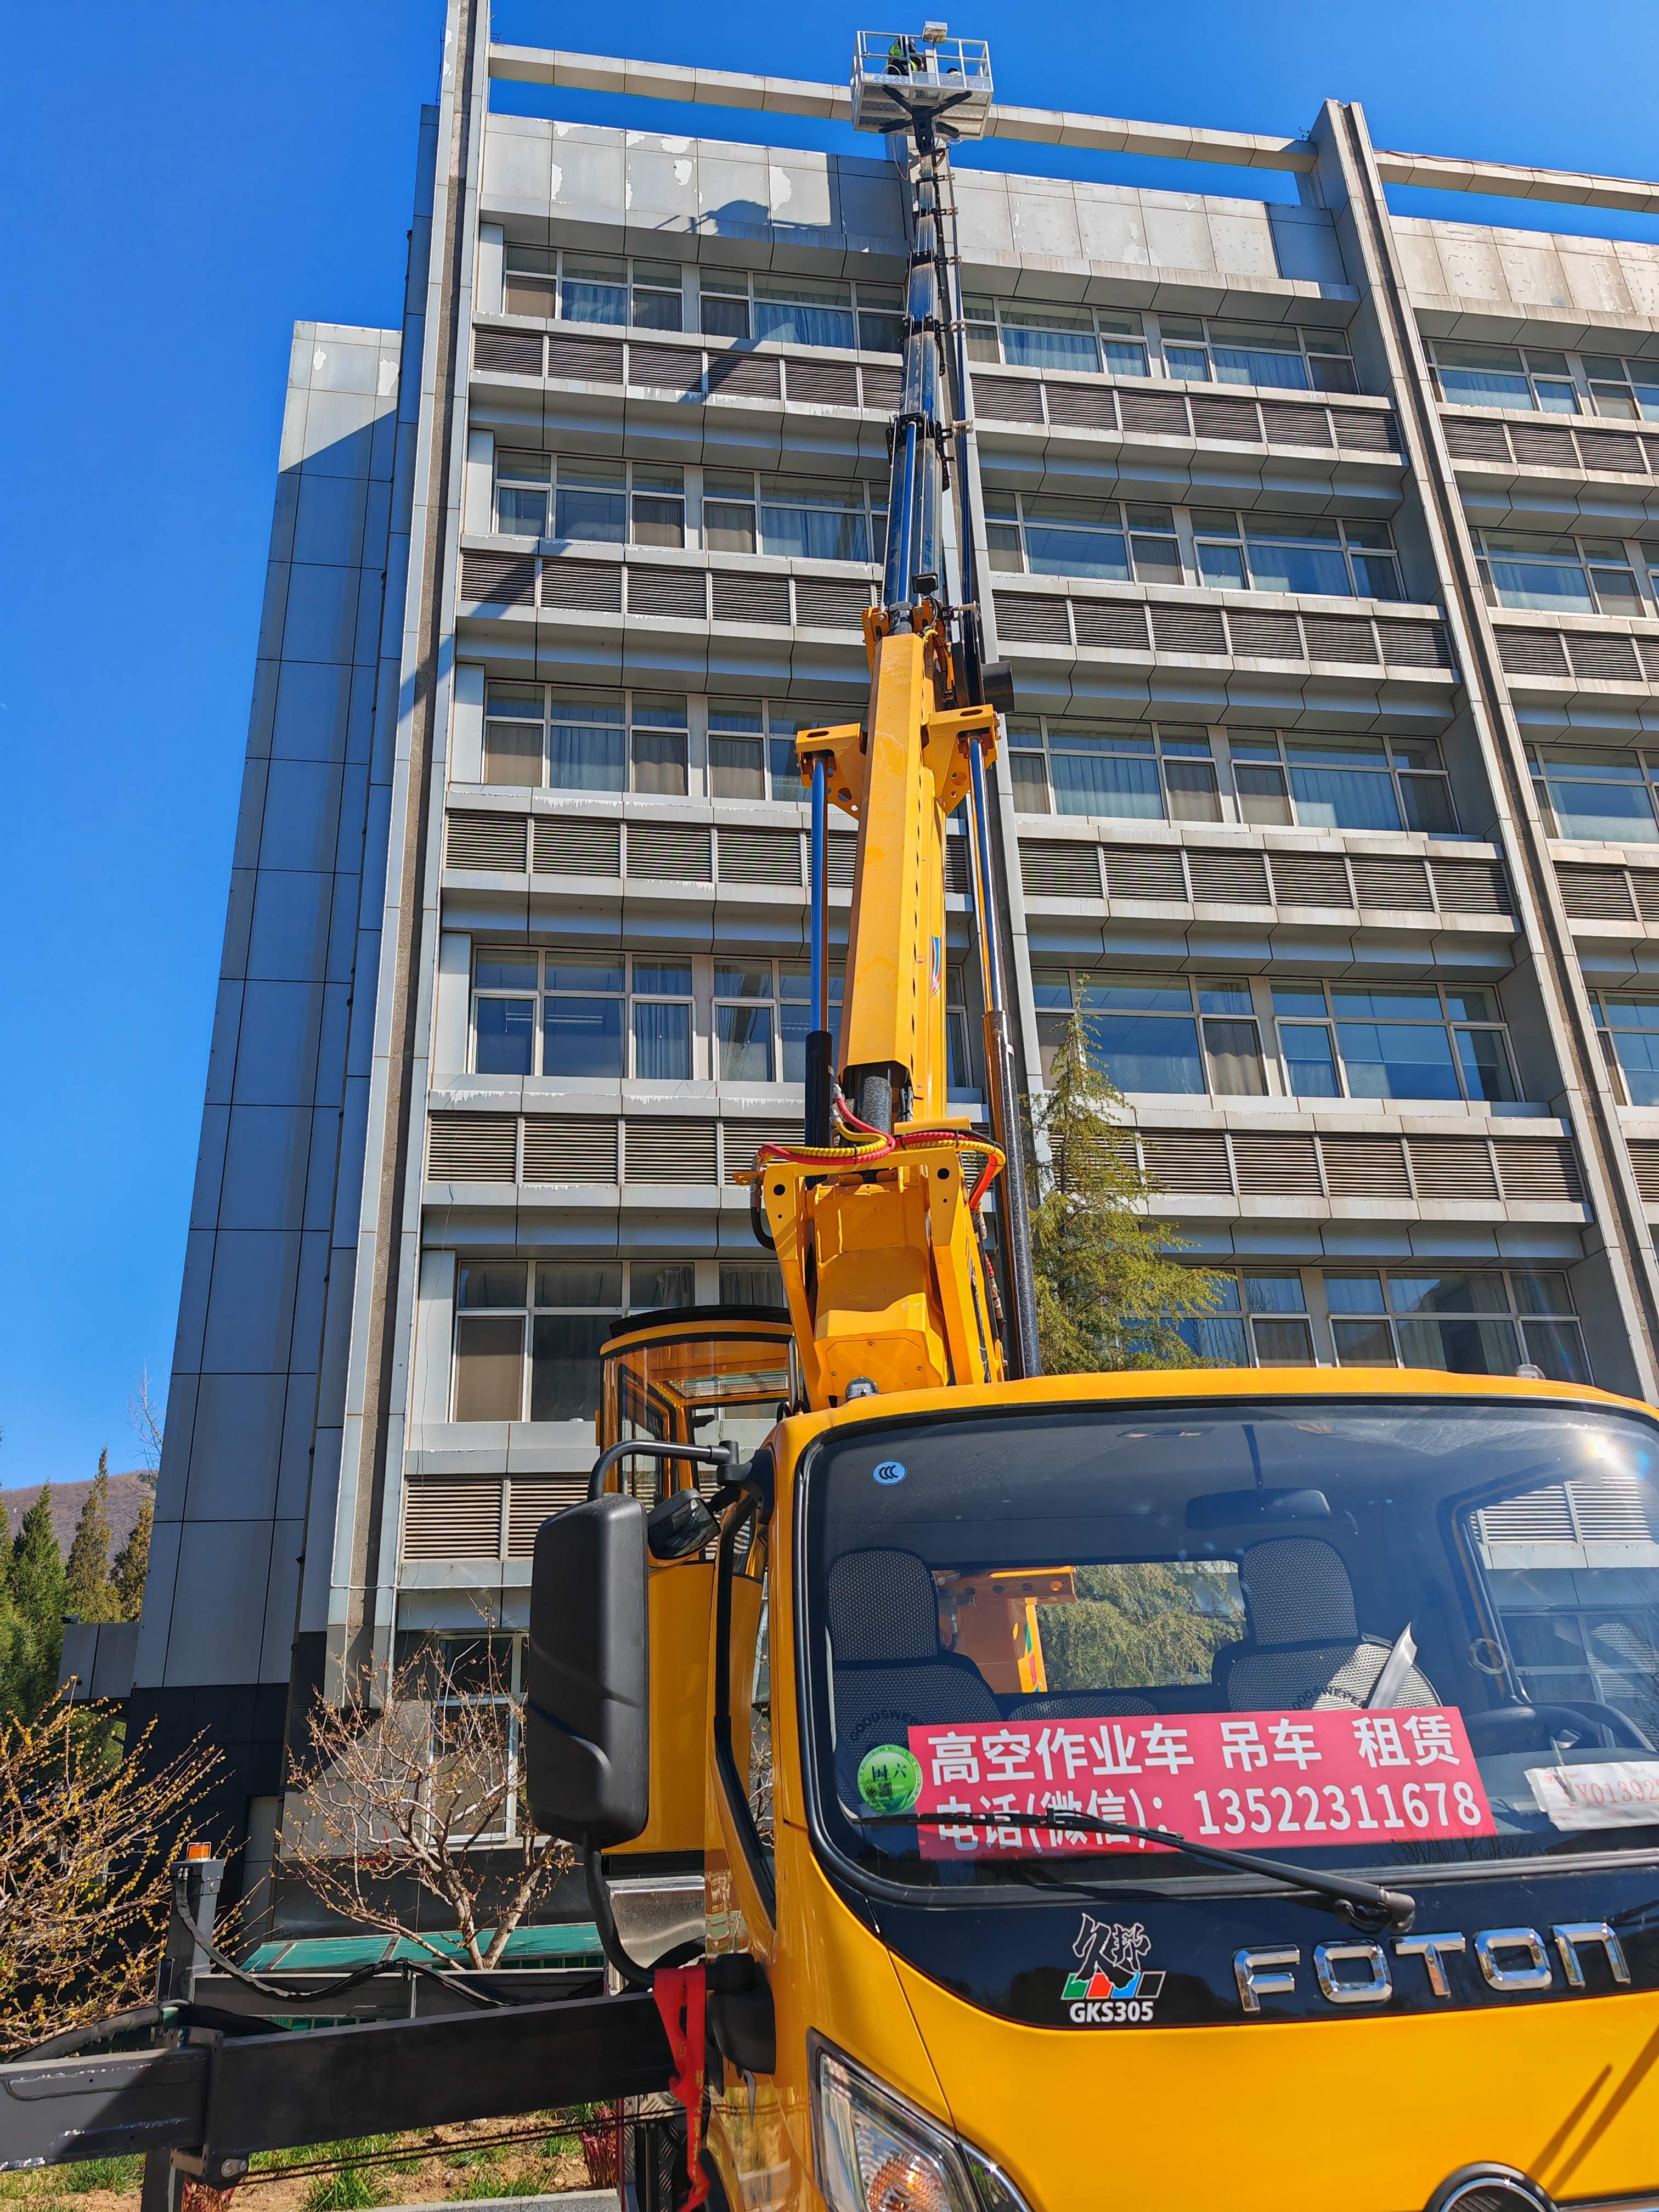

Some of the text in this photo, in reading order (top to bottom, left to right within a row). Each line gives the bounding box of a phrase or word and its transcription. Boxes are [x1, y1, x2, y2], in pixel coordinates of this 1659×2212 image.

[927, 1722, 1195, 1786] 高空作业车
[1220, 1718, 1323, 1773] 吊车
[1351, 1714, 1460, 1769] 租赁
[1193, 1781, 1482, 1835] 13522311678
[1233, 1921, 1632, 2013] FOTON
[1070, 2001, 1154, 2023] GKS305
